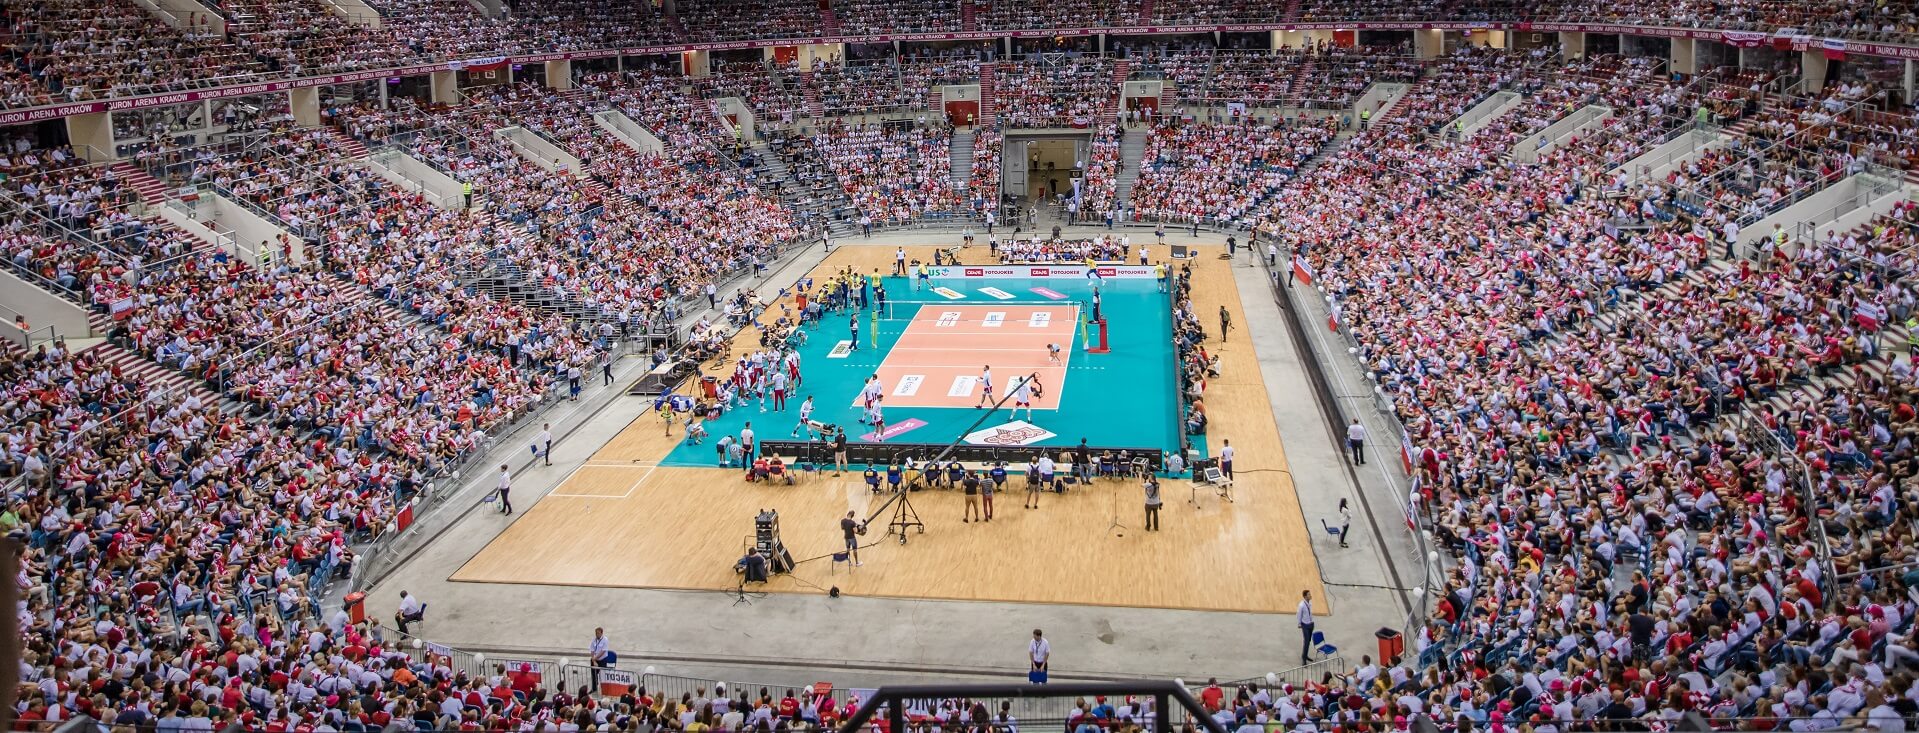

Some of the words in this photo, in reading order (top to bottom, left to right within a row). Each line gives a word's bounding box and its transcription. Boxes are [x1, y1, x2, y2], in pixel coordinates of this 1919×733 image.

[1876, 46, 1896, 56] TAURON
[1899, 48, 1919, 57] ARENA
[297, 79, 313, 87] ARENA
[342, 74, 359, 82] TAURON
[360, 72, 374, 80] ARENA
[198, 90, 221, 100] TAURON
[223, 86, 242, 96] ARENA
[135, 98, 158, 107] ARENA
[160, 93, 188, 105] KRAKÓW
[29, 109, 56, 120] ARENA
[58, 104, 92, 115] KRAKÓW
